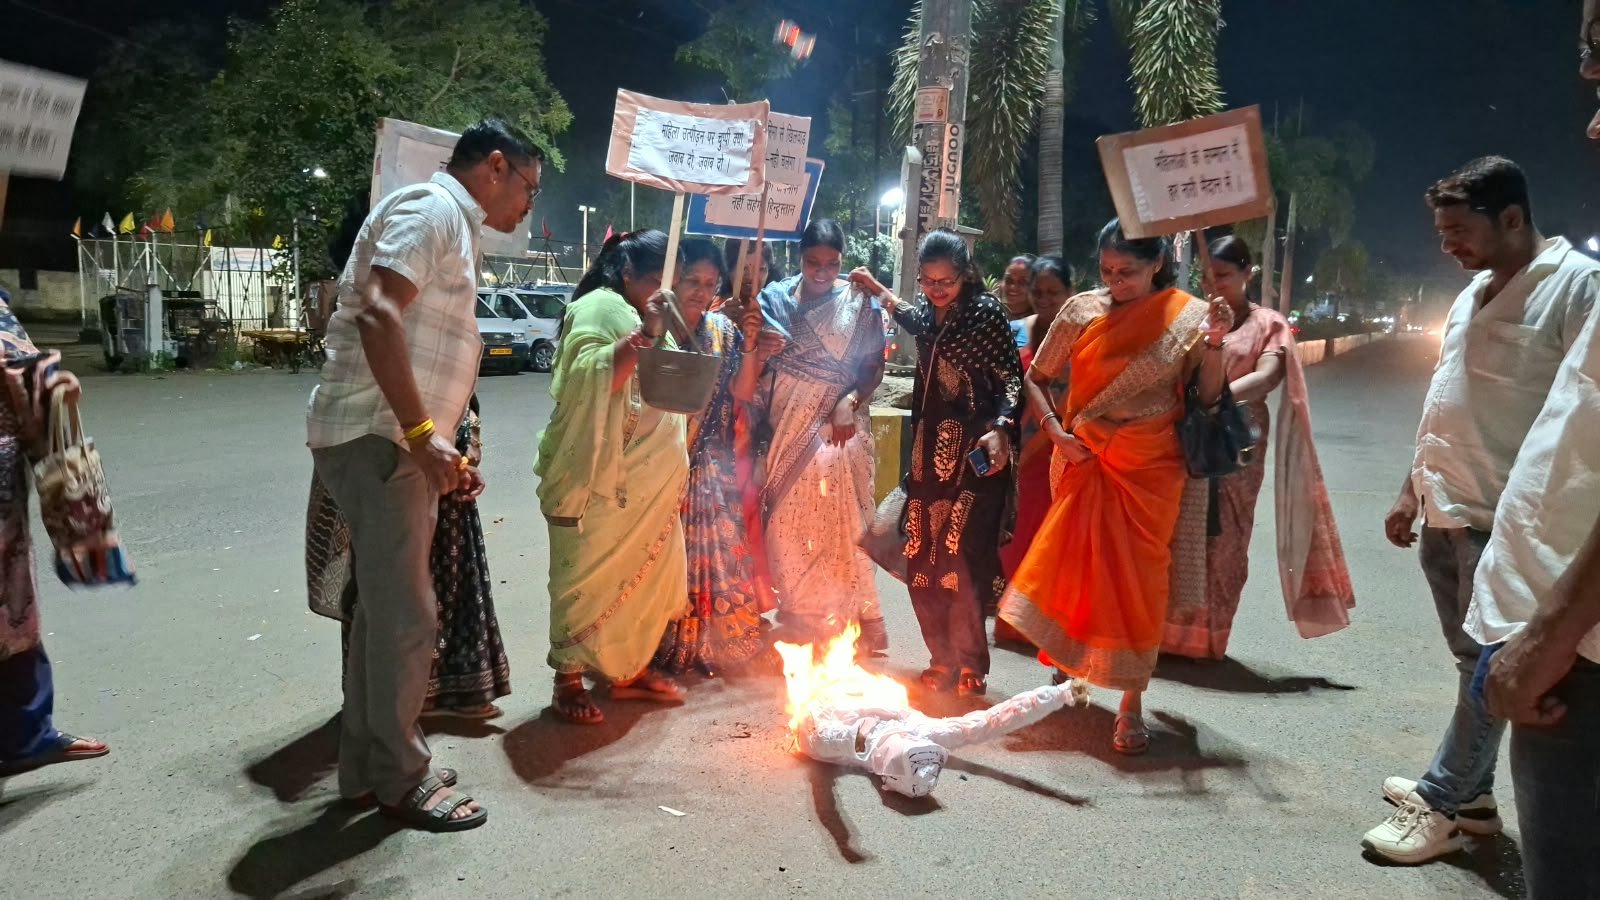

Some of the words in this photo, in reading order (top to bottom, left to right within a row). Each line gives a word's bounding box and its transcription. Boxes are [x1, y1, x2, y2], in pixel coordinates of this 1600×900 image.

[662, 120, 680, 140] महिला
[682, 125, 705, 146] उत्पीड़न
[707, 131, 716, 145] पर
[717, 128, 731, 151] चुप्पी
[668, 150, 685, 166] जवाब
[698, 155, 715, 171] जवाब
